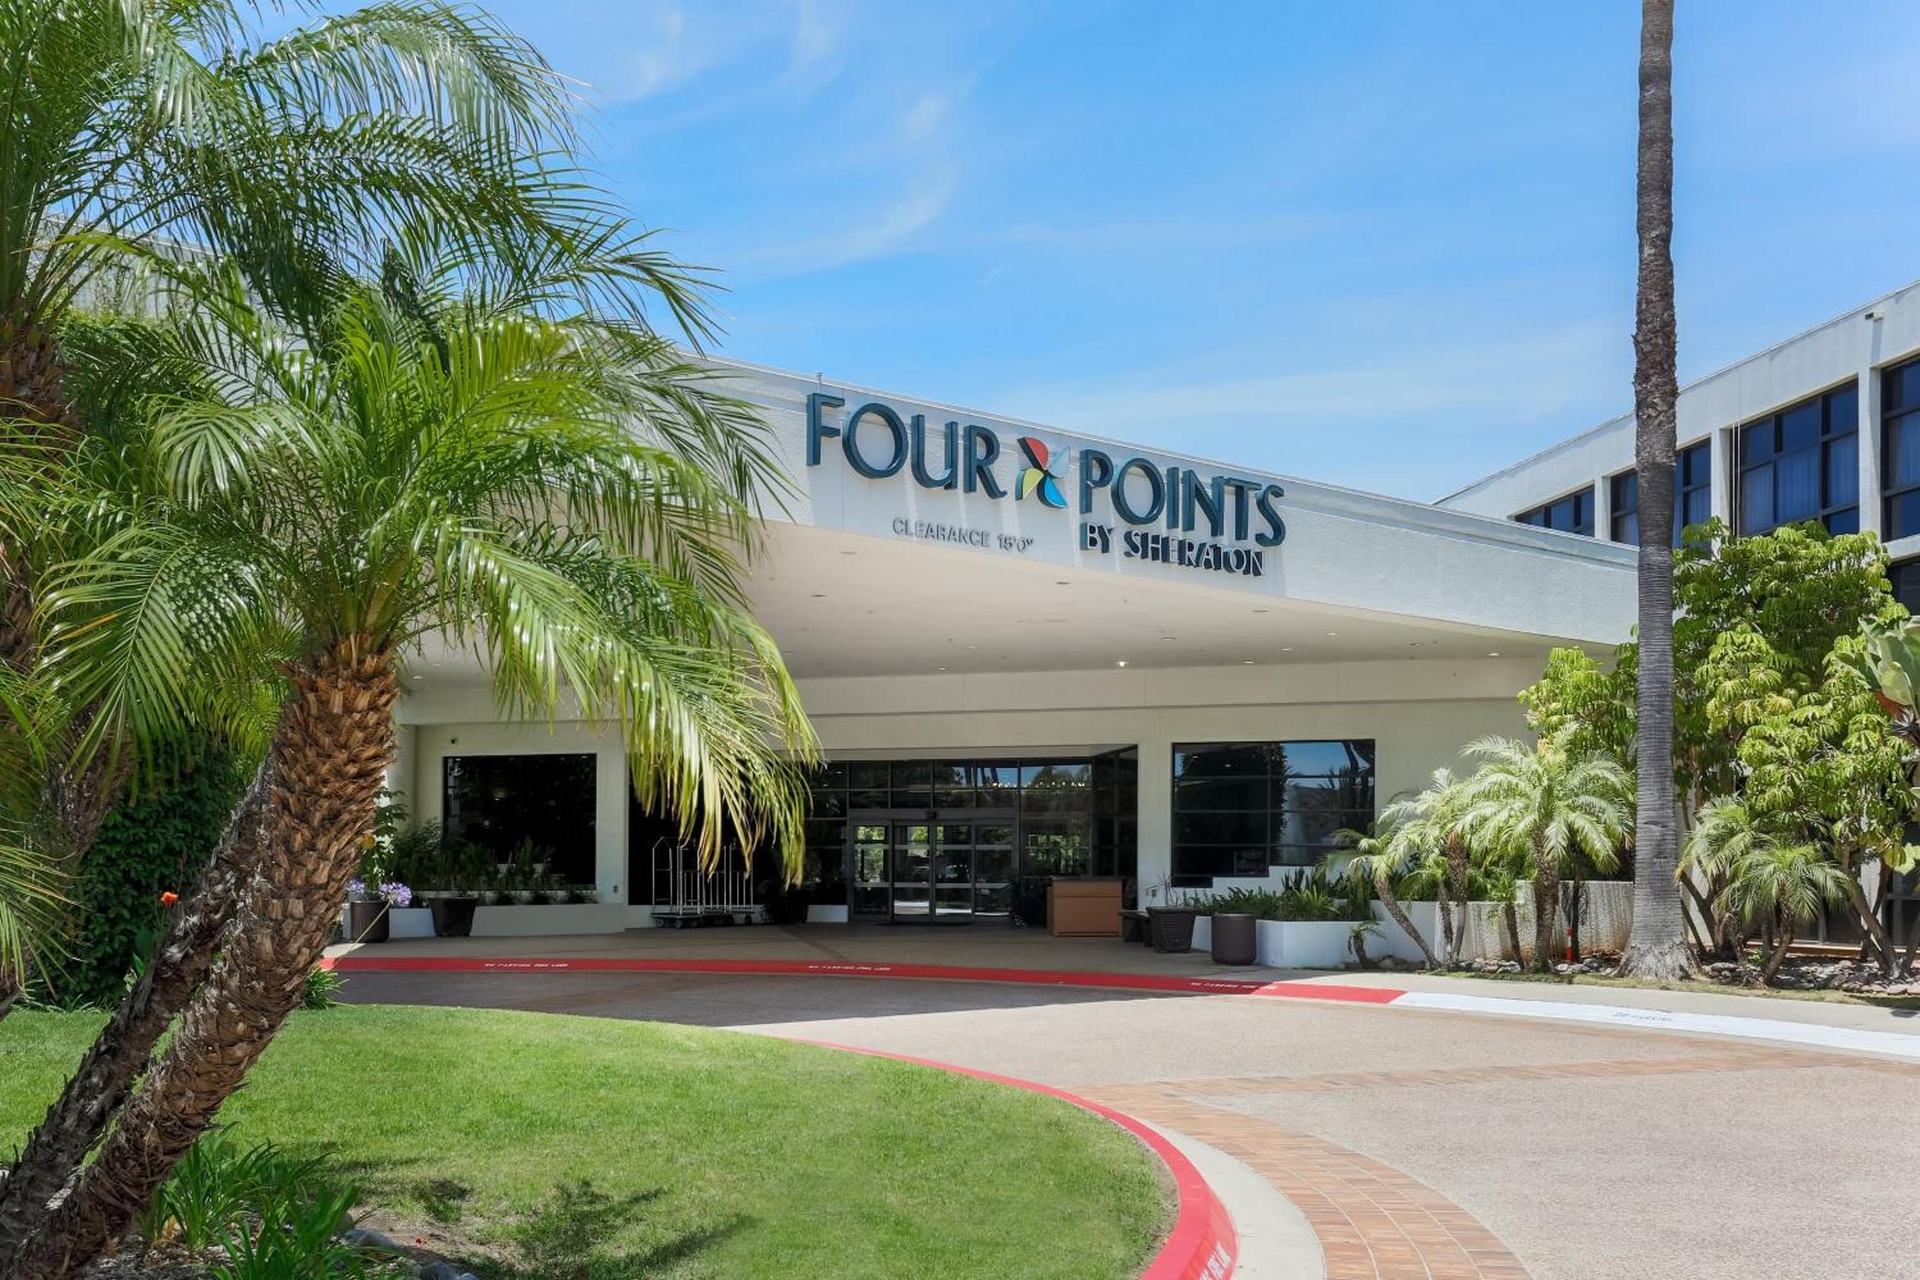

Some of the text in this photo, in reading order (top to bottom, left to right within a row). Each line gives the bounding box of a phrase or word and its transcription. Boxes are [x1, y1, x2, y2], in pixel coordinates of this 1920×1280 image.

[806, 392, 1286, 547] FOUR POINTS
[892, 517, 991, 547] CLEARANCE
[1080, 523, 1265, 577] BY SHERATON
